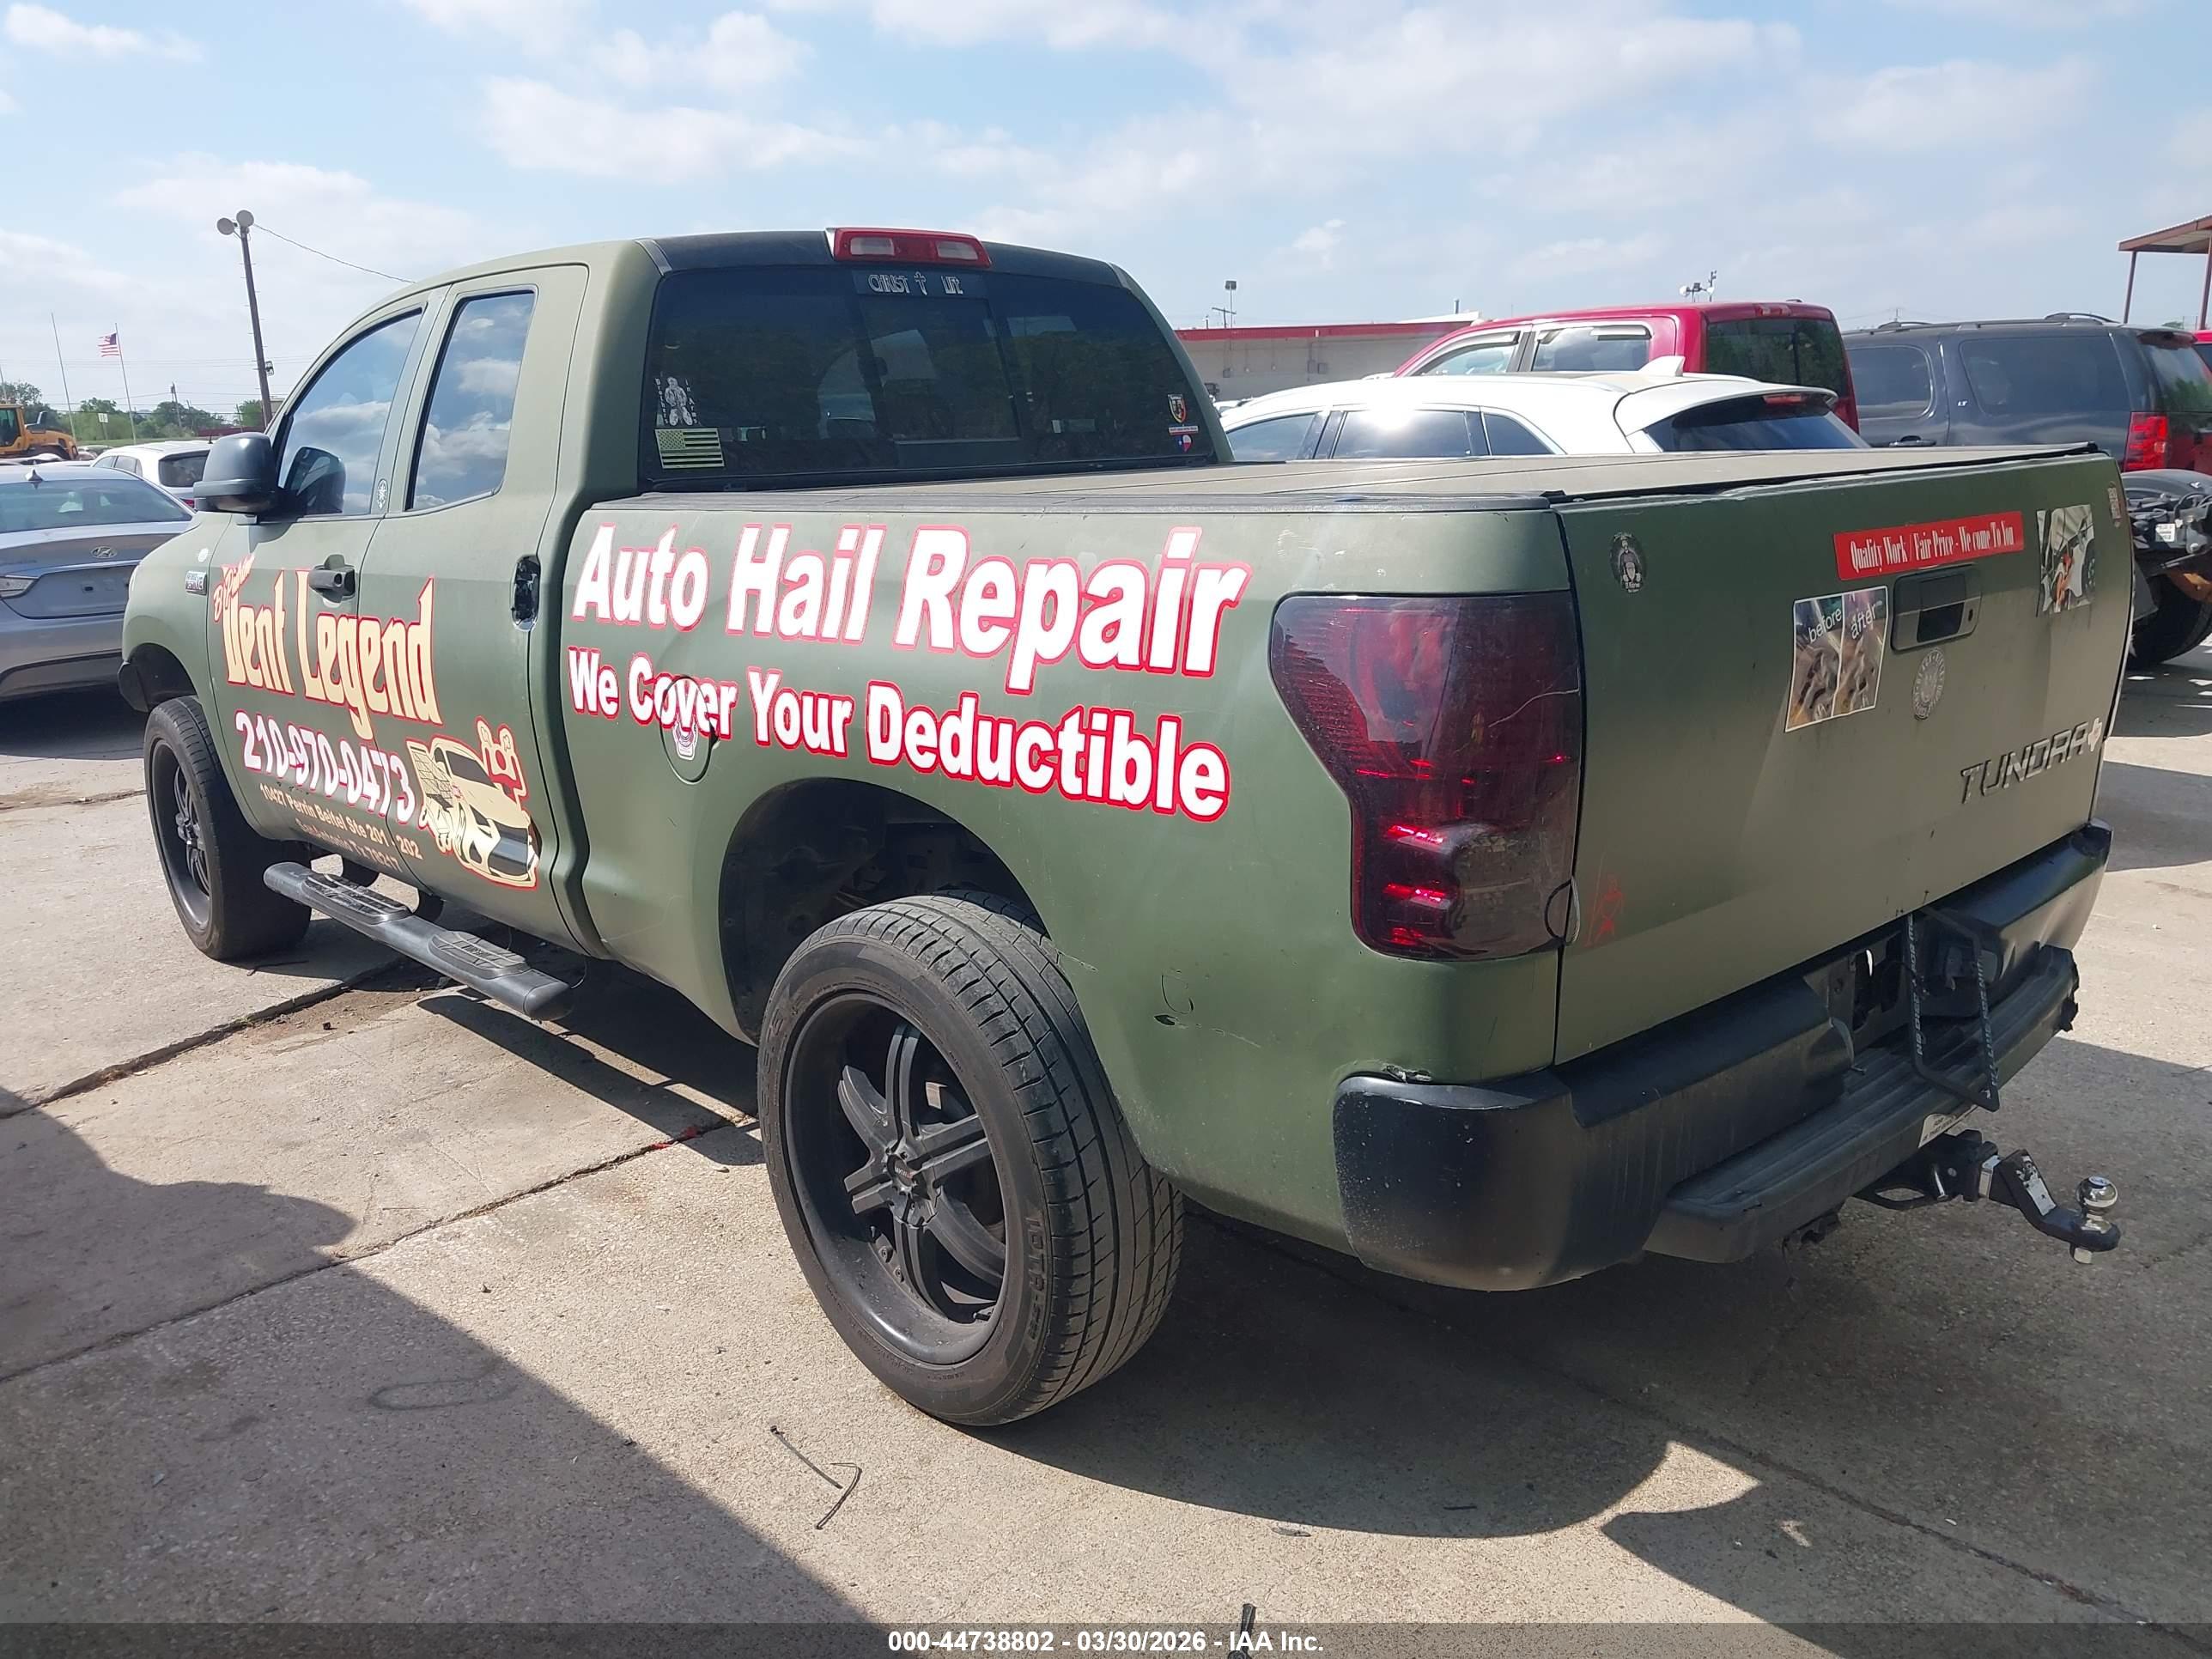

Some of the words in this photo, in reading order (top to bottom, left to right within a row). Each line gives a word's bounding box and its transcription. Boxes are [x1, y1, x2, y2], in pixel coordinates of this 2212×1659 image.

[1850, 538, 1883, 574] Quality
[1882, 536, 1908, 565] Work
[1913, 532, 1932, 561] Fair
[1932, 529, 1954, 557] Price
[1990, 521, 2002, 549] To
[2001, 520, 2015, 546] You
[572, 523, 709, 630] Auto
[726, 523, 885, 644] Hail
[892, 525, 1253, 695] Repair
[1808, 608, 1842, 644] before
[1850, 604, 1876, 640] after
[221, 564, 295, 696] Dent
[295, 569, 444, 741] Legend
[234, 709, 416, 824] 210-970-0473
[568, 647, 620, 718] We
[628, 653, 738, 740] Cover
[748, 668, 854, 758] Your
[866, 680, 1231, 823] Deductible
[1960, 721, 2089, 805] TUNDRA
[259, 782, 287, 808] 10427
[288, 795, 318, 819] Perrin
[315, 805, 347, 830] Beitel
[346, 816, 368, 839] Ste
[366, 823, 391, 847] 201
[395, 835, 423, 860] 202
